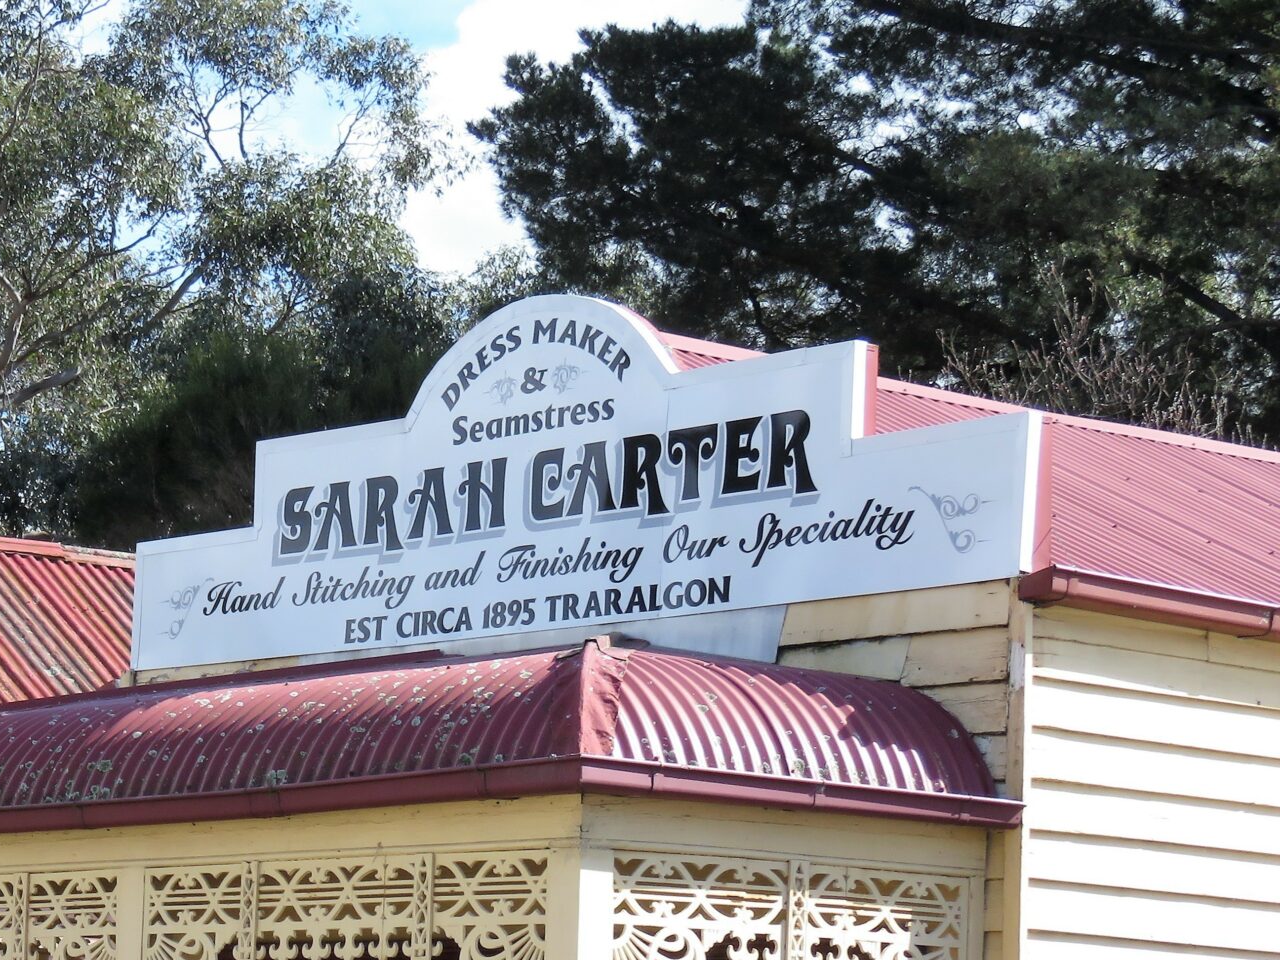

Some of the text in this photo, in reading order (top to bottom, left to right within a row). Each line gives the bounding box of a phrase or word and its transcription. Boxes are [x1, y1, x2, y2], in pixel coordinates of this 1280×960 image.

[441, 317, 631, 412] DRESS MAKER
[520, 367, 548, 395] &
[452, 399, 615, 446] Seamstress
[279, 409, 819, 555] SARAH CARTER
[203, 498, 916, 616] Hand Stitching and Finishing Our Speciality
[344, 576, 731, 644] EST CIRCA 1895 TRARALGON
